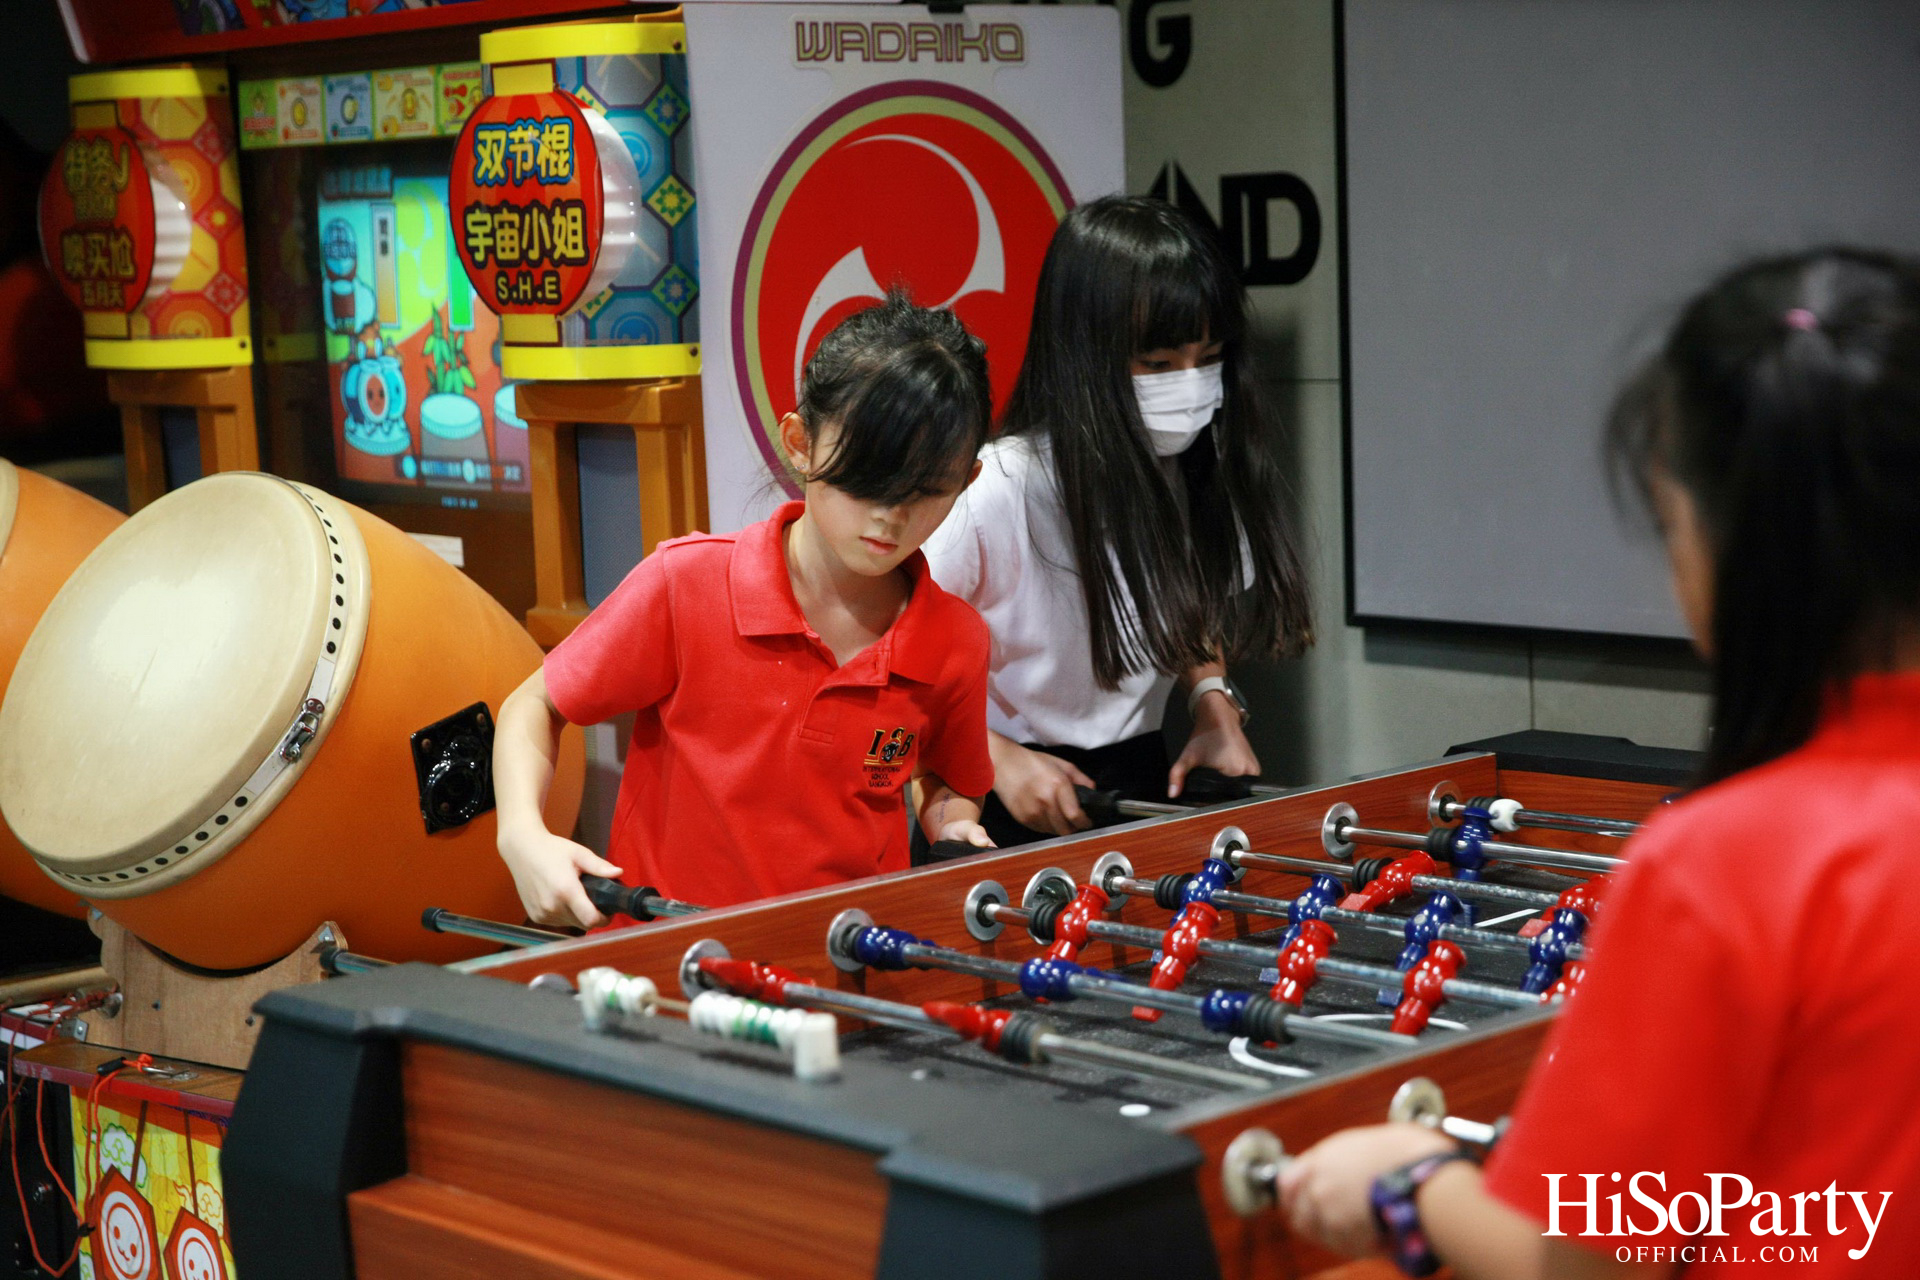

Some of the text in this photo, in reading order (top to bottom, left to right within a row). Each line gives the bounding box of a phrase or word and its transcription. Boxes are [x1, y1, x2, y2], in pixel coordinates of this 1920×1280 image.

[796, 22, 1024, 62] WADAIKO
[475, 121, 571, 182] 双节棍
[464, 205, 586, 264] 宇宙小姐
[497, 276, 559, 300] S.H.E
